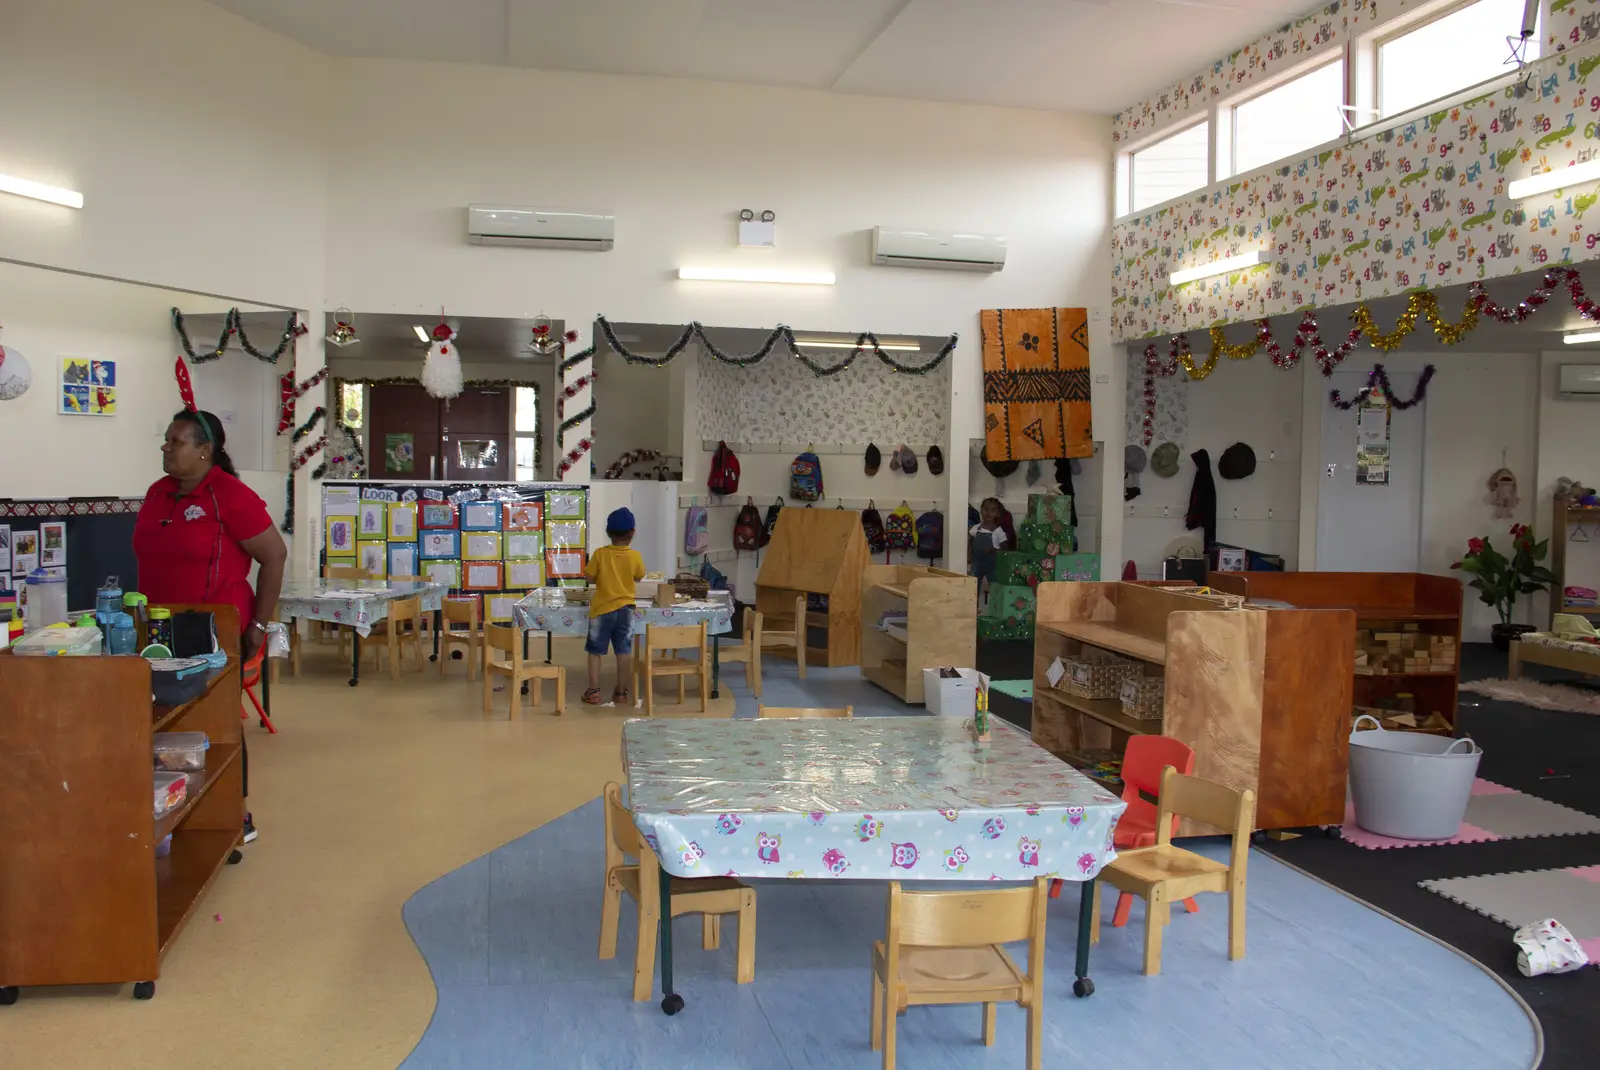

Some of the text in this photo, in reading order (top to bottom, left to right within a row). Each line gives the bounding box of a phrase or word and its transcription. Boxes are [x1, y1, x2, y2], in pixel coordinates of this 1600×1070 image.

[1370, 8, 1377, 20] 3
[1314, 32, 1320, 44] 4
[1569, 26, 1580, 43] 4
[1293, 40, 1299, 54] 5
[1268, 49, 1273, 60] 4
[1249, 56, 1255, 68] 5
[1237, 71, 1242, 83] 9
[1568, 62, 1576, 82] 1
[1573, 96, 1585, 109] 10
[1590, 96, 1600, 112] 9
[1423, 116, 1430, 130] 1
[1490, 118, 1499, 133] 4
[1543, 117, 1551, 132] 8
[1565, 113, 1574, 127] 7
[1459, 124, 1468, 141] 5
[1584, 121, 1597, 139] 6
[1397, 135, 1404, 148] 2
[1479, 140, 1488, 156] 3
[1427, 144, 1435, 154] 10
[1440, 144, 1448, 158] 9
[1313, 154, 1318, 167] 1
[1365, 159, 1372, 172] 4
[1404, 160, 1411, 173] 8
[1421, 157, 1428, 170] 7
[1489, 152, 1497, 169] 1
[1292, 170, 1298, 181] 2
[1341, 163, 1349, 178] 5
[1435, 166, 1444, 181] 6
[1326, 180, 1332, 192] 9
[1357, 179, 1363, 191] 3
[1459, 173, 1466, 188] 2
[1267, 190, 1272, 202] 4
[1312, 191, 1317, 201] 7
[1365, 188, 1370, 204] 1
[1493, 184, 1503, 195] 10
[1248, 194, 1254, 206] 5
[1298, 193, 1304, 204] 8
[1422, 198, 1430, 212] 4
[1323, 199, 1329, 212] 6
[1341, 206, 1347, 218] 2
[1396, 201, 1403, 217] 5
[1467, 201, 1475, 215] 8
[1487, 199, 1495, 212] 7
[1565, 196, 1574, 216] 1
[1236, 207, 1241, 219] 9
[1261, 207, 1266, 219] 3
[1503, 209, 1514, 225] 6
[1173, 218, 1178, 230] 5
[1368, 217, 1376, 227] 10
[1379, 218, 1386, 231] 9
[1413, 218, 1420, 232] 3
[1530, 218, 1538, 233] 2
[1233, 225, 1239, 237] 6
[1248, 232, 1253, 242] 2
[1291, 229, 1298, 242] 5
[1313, 227, 1319, 239] 4
[1347, 231, 1354, 242] 8
[1363, 229, 1369, 240] 7
[1569, 231, 1581, 243] 10
[1422, 230, 1429, 246] 1
[1586, 233, 1597, 250] 9
[1278, 243, 1284, 255] 9
[1306, 244, 1311, 256] 3
[1375, 239, 1383, 253] 6
[1488, 243, 1497, 258] 4
[1396, 247, 1402, 260] 2
[1457, 245, 1466, 262] 5
[1539, 249, 1548, 263] 8
[1561, 247, 1570, 261] 7
[1275, 262, 1280, 274] 6
[1312, 256, 1318, 269] 1
[1424, 260, 1434, 270] 10
[1438, 262, 1446, 276] 9
[1292, 270, 1297, 281] 2
[1340, 269, 1347, 283] 5
[1364, 267, 1371, 281] 4
[1477, 264, 1485, 278] 3
[1402, 274, 1409, 286] 8
[1420, 273, 1427, 285] 7
[1247, 288, 1253, 300] 5
[1266, 287, 1272, 299] 4
[1325, 284, 1331, 296] 9
[1355, 286, 1362, 299] 3
[1297, 293, 1302, 304] 8
[1311, 293, 1316, 304] 7
[1172, 304, 1177, 315] 5
[1188, 303, 1193, 313] 4
[1235, 300, 1240, 311] 9
[1260, 303, 1265, 314] 3
[363, 489, 394, 501] LOOK
[404, 490, 416, 503] AT
[424, 489, 442, 500] OUR
